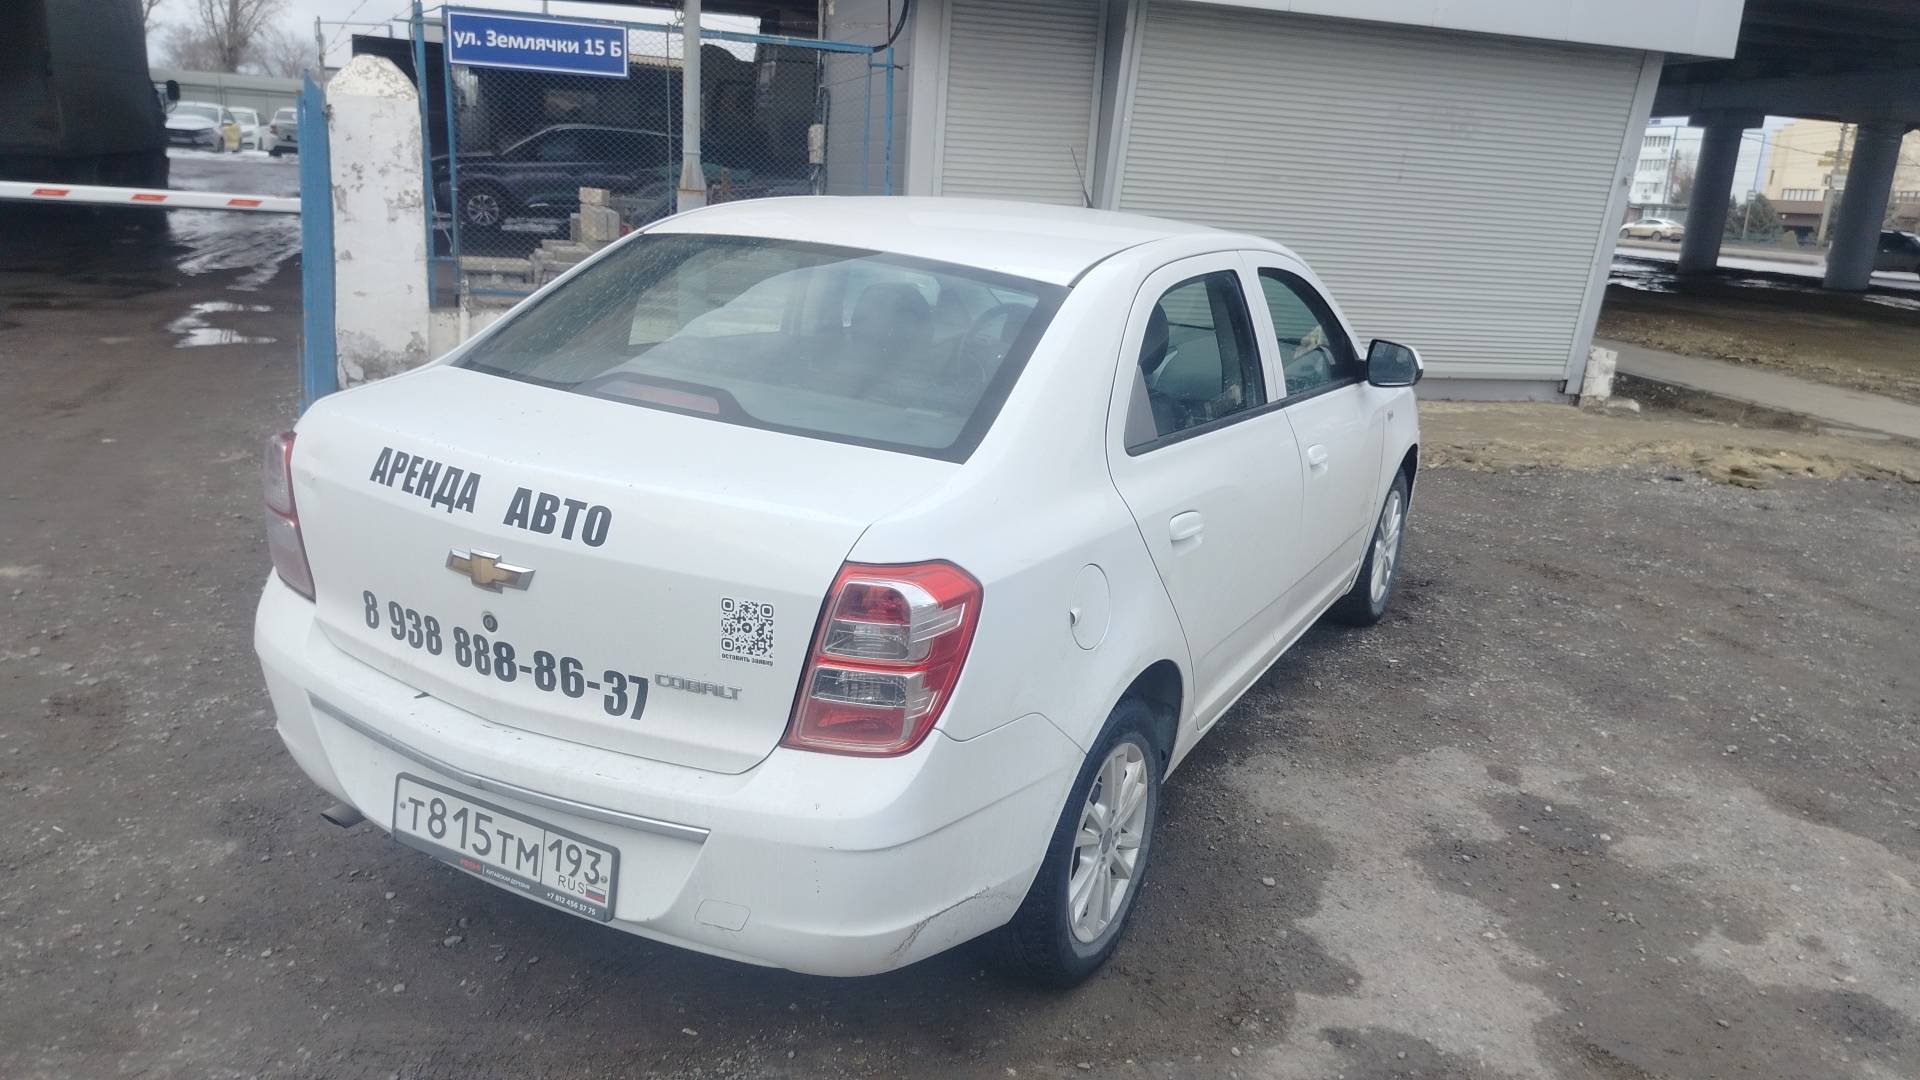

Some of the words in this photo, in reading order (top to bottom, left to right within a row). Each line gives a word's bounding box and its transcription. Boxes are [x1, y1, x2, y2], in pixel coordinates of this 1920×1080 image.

[453, 31, 481, 48] ул.
[486, 29, 579, 54] Землячки
[584, 38, 605, 56] 15
[610, 41, 622, 57] Б
[369, 446, 481, 514] АРЕНДА
[502, 486, 613, 548] АВТО
[363, 590, 380, 629] 8
[388, 601, 443, 656] 938
[453, 626, 649, 721] 888-86-37
[655, 674, 742, 700] COBALT
[548, 838, 601, 885] 193
[558, 874, 585, 895] RUS
